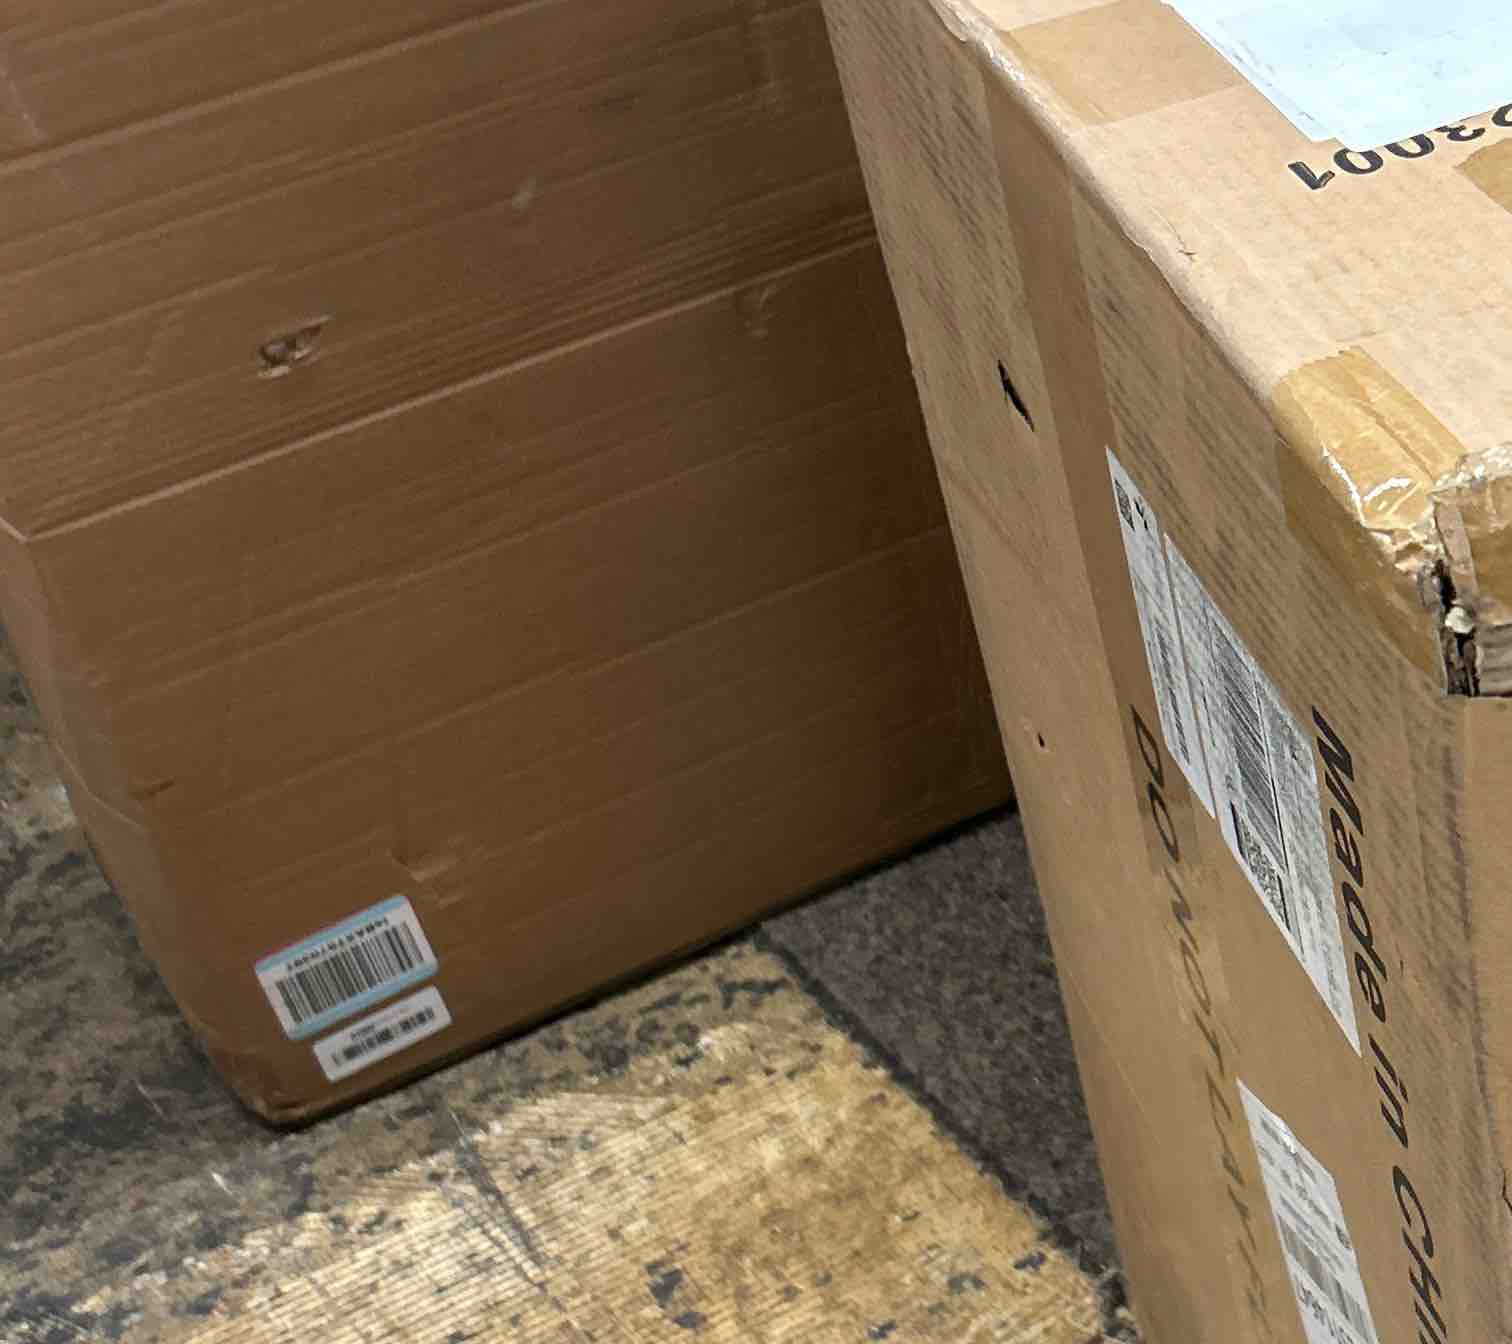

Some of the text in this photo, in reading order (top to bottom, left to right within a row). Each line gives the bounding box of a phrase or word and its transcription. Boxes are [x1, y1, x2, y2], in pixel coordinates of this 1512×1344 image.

[1131, 704, 1180, 863] DO
[1168, 878, 1225, 1074] NOT
[1313, 705, 1387, 1022] Made
[1368, 1033, 1408, 1148] in
